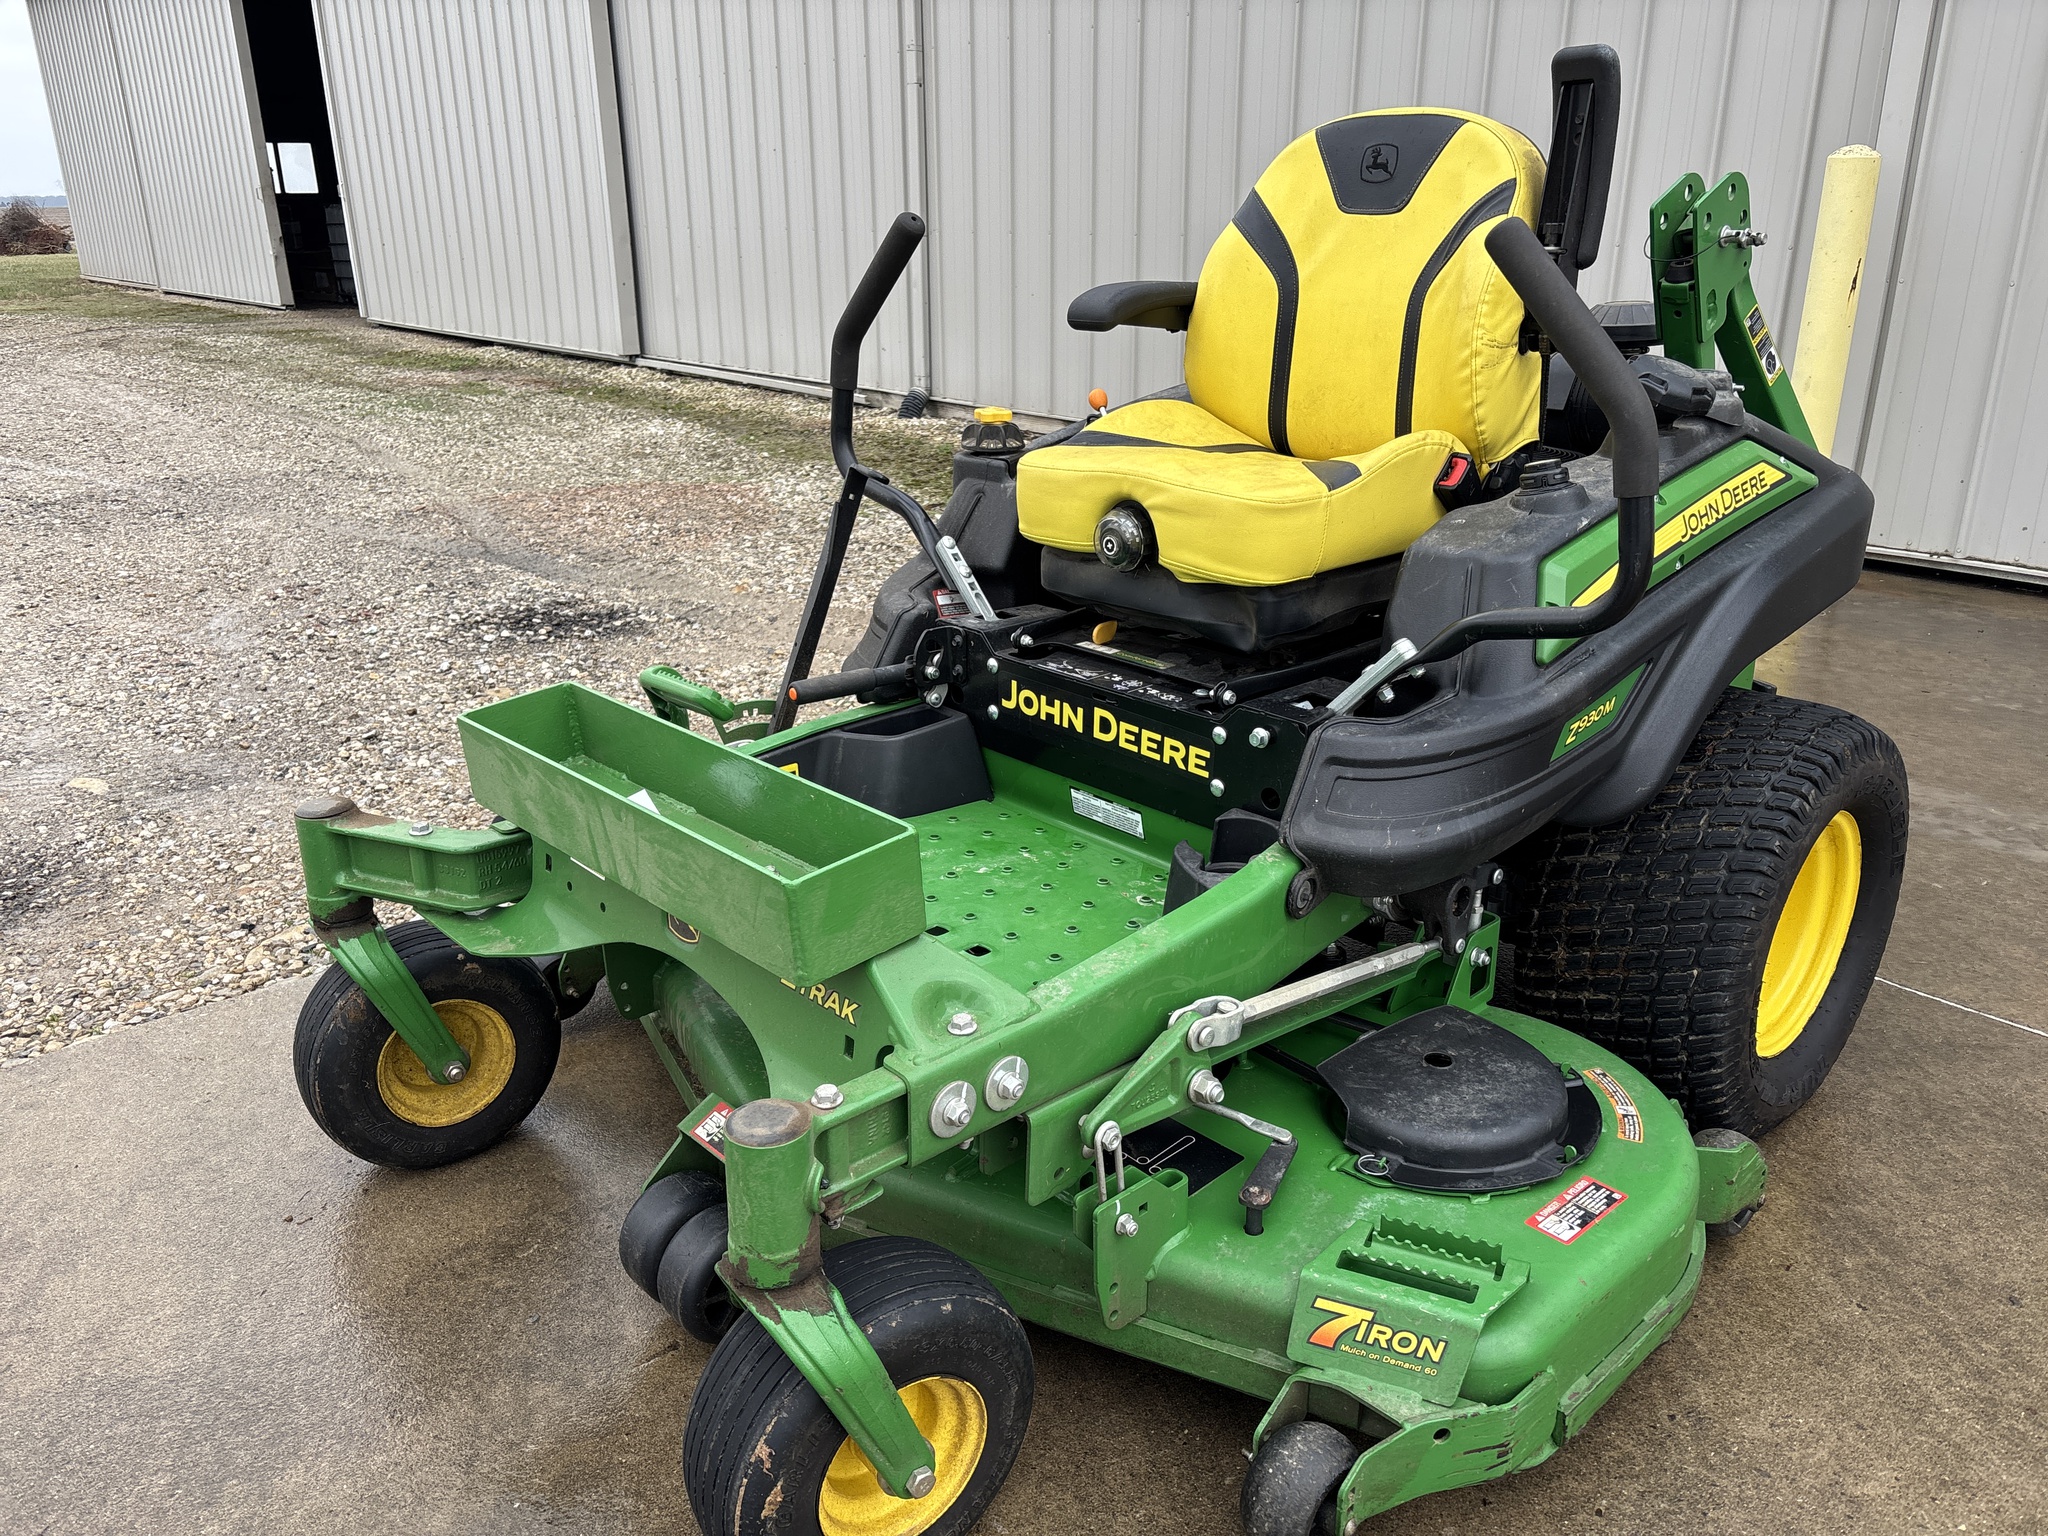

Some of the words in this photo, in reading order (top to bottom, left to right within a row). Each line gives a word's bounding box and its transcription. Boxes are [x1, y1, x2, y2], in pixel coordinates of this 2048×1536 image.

[1681, 498, 1720, 540] JOHN
[1720, 470, 1768, 512] DEERE
[1001, 680, 1083, 733] JOHN
[1093, 706, 1211, 778] DEERE
[1564, 695, 1617, 747] Z930M
[780, 977, 860, 1027] RAK
[1539, 1200, 1562, 1217] DANGER
[1307, 1295, 1377, 1350] 7
[1354, 1319, 1448, 1364] IRON
[1340, 1343, 1367, 1358] Mulch
[1368, 1352, 1381, 1361] on
[1382, 1355, 1422, 1373] Demand
[1424, 1367, 1438, 1377] 60
